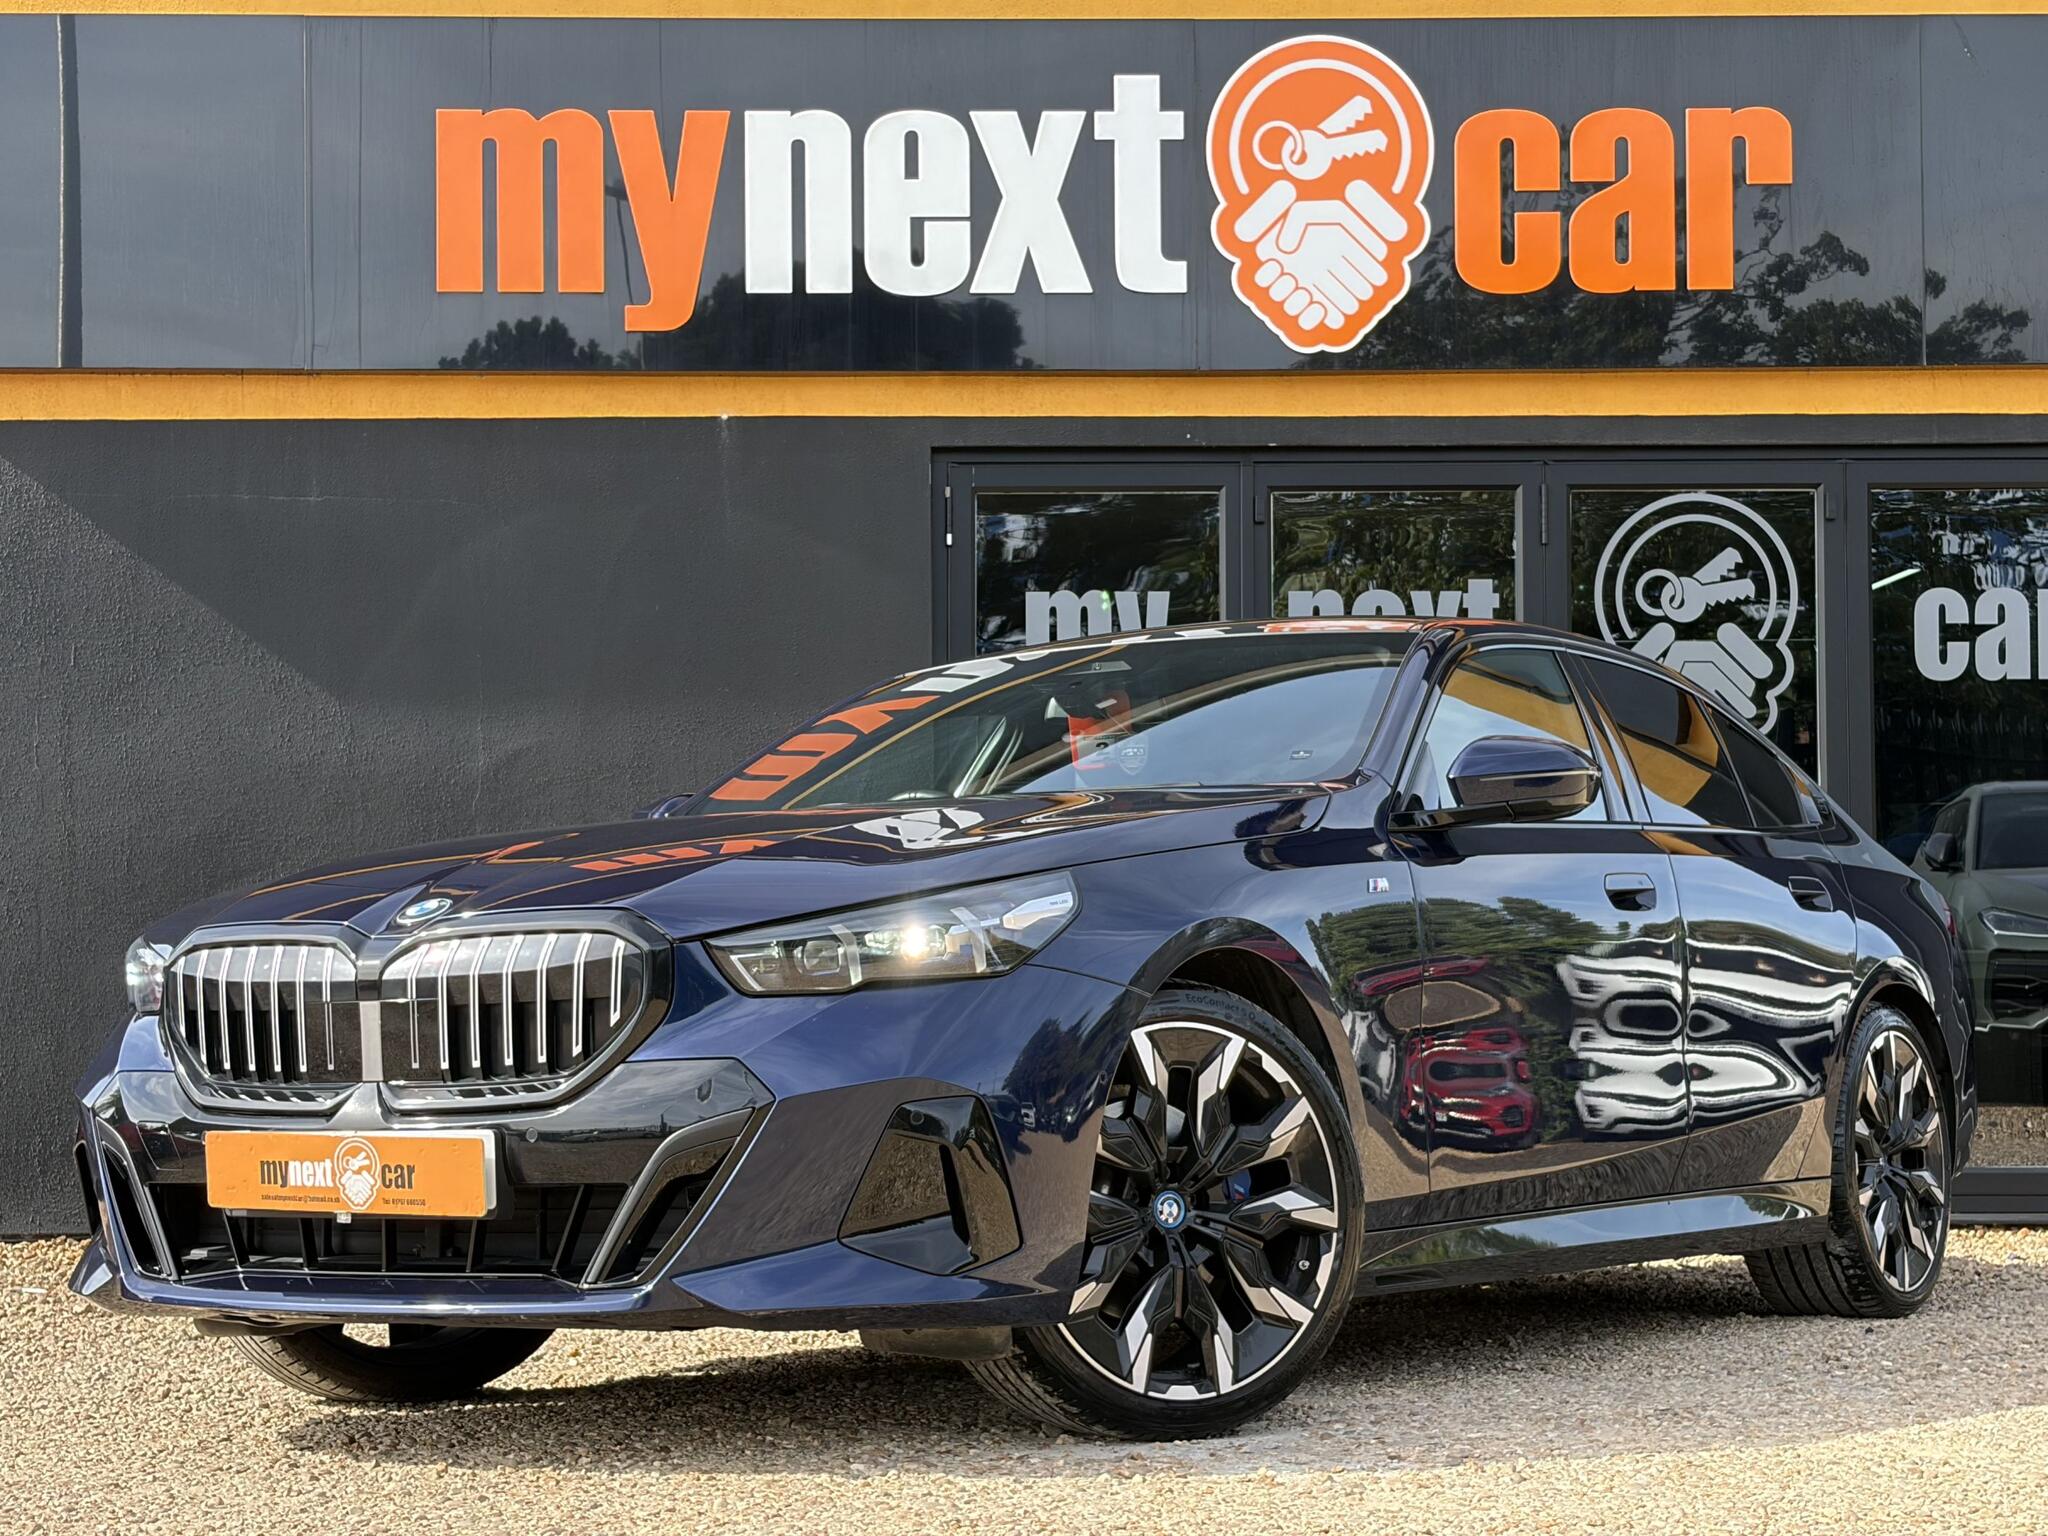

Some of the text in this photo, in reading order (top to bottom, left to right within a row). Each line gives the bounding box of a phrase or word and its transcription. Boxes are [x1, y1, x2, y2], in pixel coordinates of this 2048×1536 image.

[1454, 106, 1793, 295] car
[1913, 586, 2048, 682] ca
[381, 1163, 416, 1189] car
